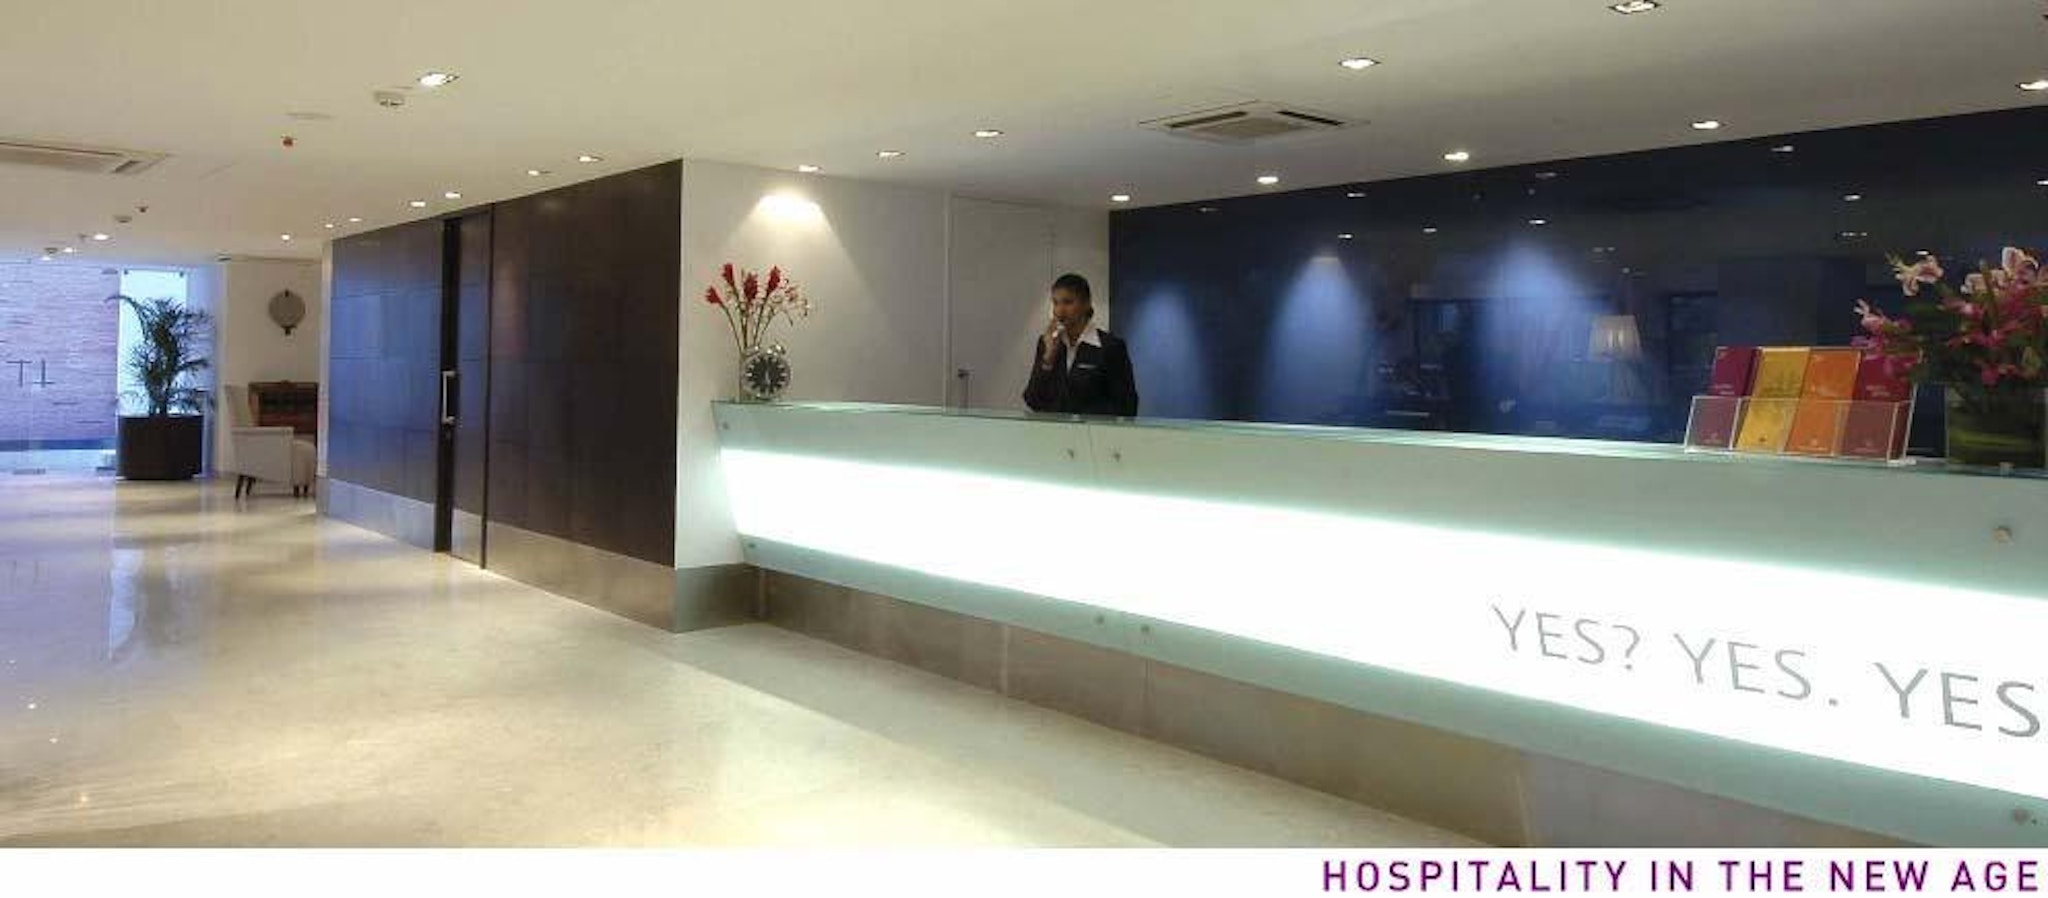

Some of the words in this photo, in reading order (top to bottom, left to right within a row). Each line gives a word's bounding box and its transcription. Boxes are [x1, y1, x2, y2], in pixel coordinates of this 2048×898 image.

[1493, 607, 1640, 671] YES?
[1673, 633, 1838, 707] YES.
[1873, 662, 2041, 738] YES
